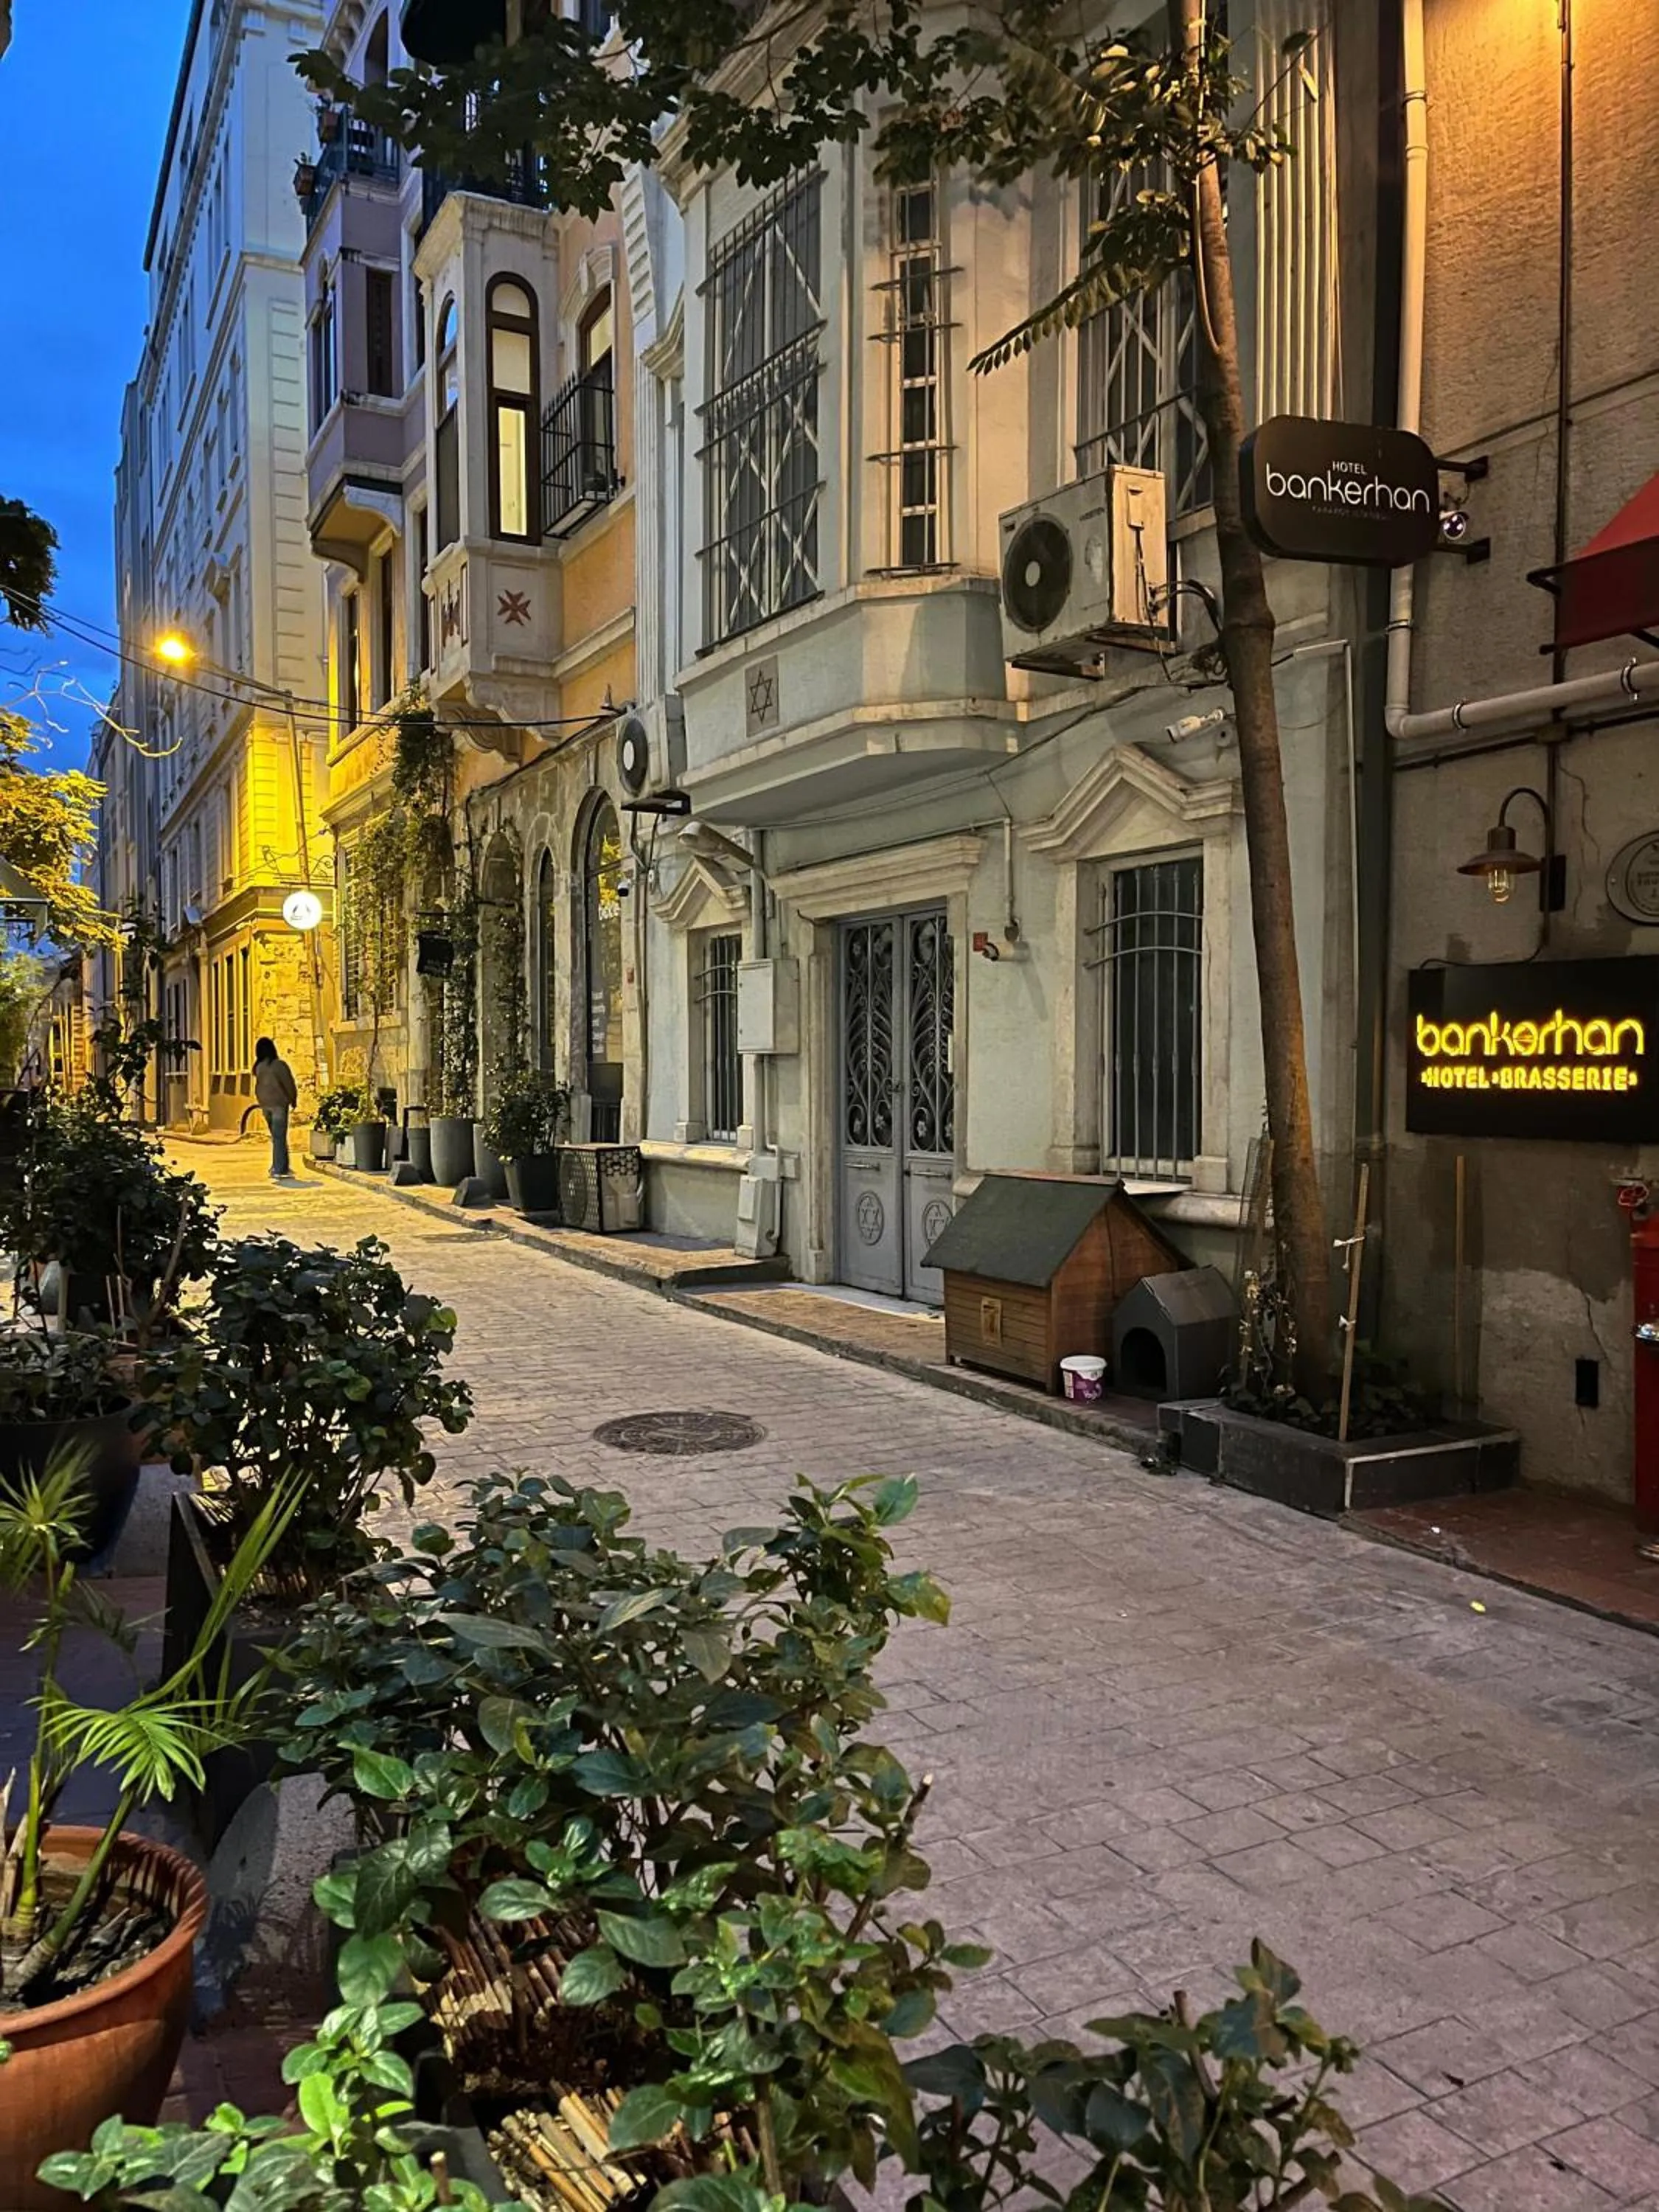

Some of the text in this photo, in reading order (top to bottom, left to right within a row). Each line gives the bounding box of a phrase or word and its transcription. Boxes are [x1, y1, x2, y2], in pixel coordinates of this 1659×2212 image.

[1265, 462, 1430, 514] bankerhan
[1332, 460, 1367, 476] HOTEL
[1416, 1008, 1645, 1057] bankerhan
